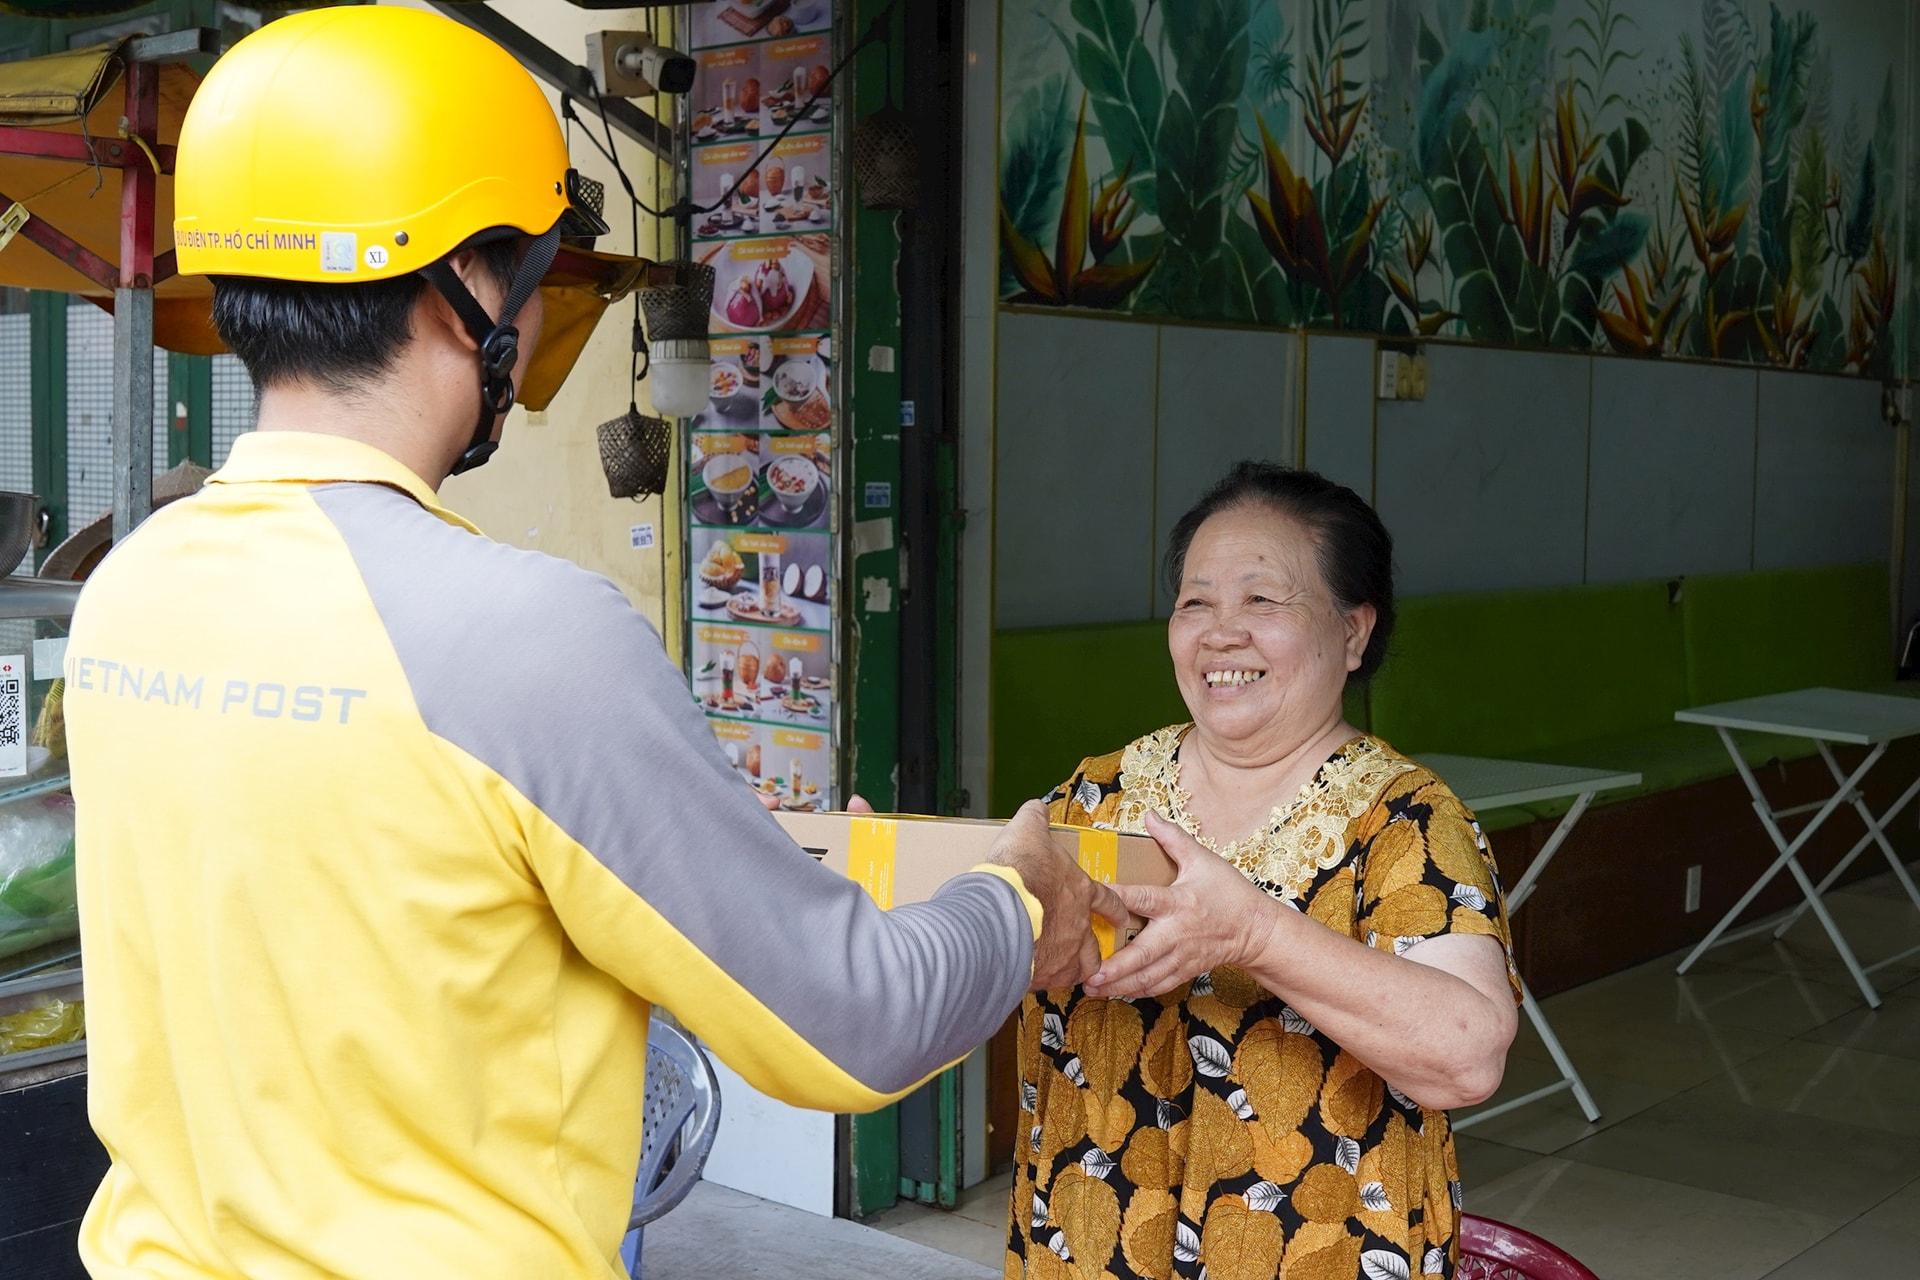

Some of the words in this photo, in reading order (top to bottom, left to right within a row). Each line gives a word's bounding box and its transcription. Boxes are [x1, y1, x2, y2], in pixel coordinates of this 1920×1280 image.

[207, 232, 222, 248] TP.
[246, 229, 269, 249] CHÍ
[274, 233, 316, 249] MINH
[369, 250, 386, 264] XL
[221, 679, 368, 724] POST
